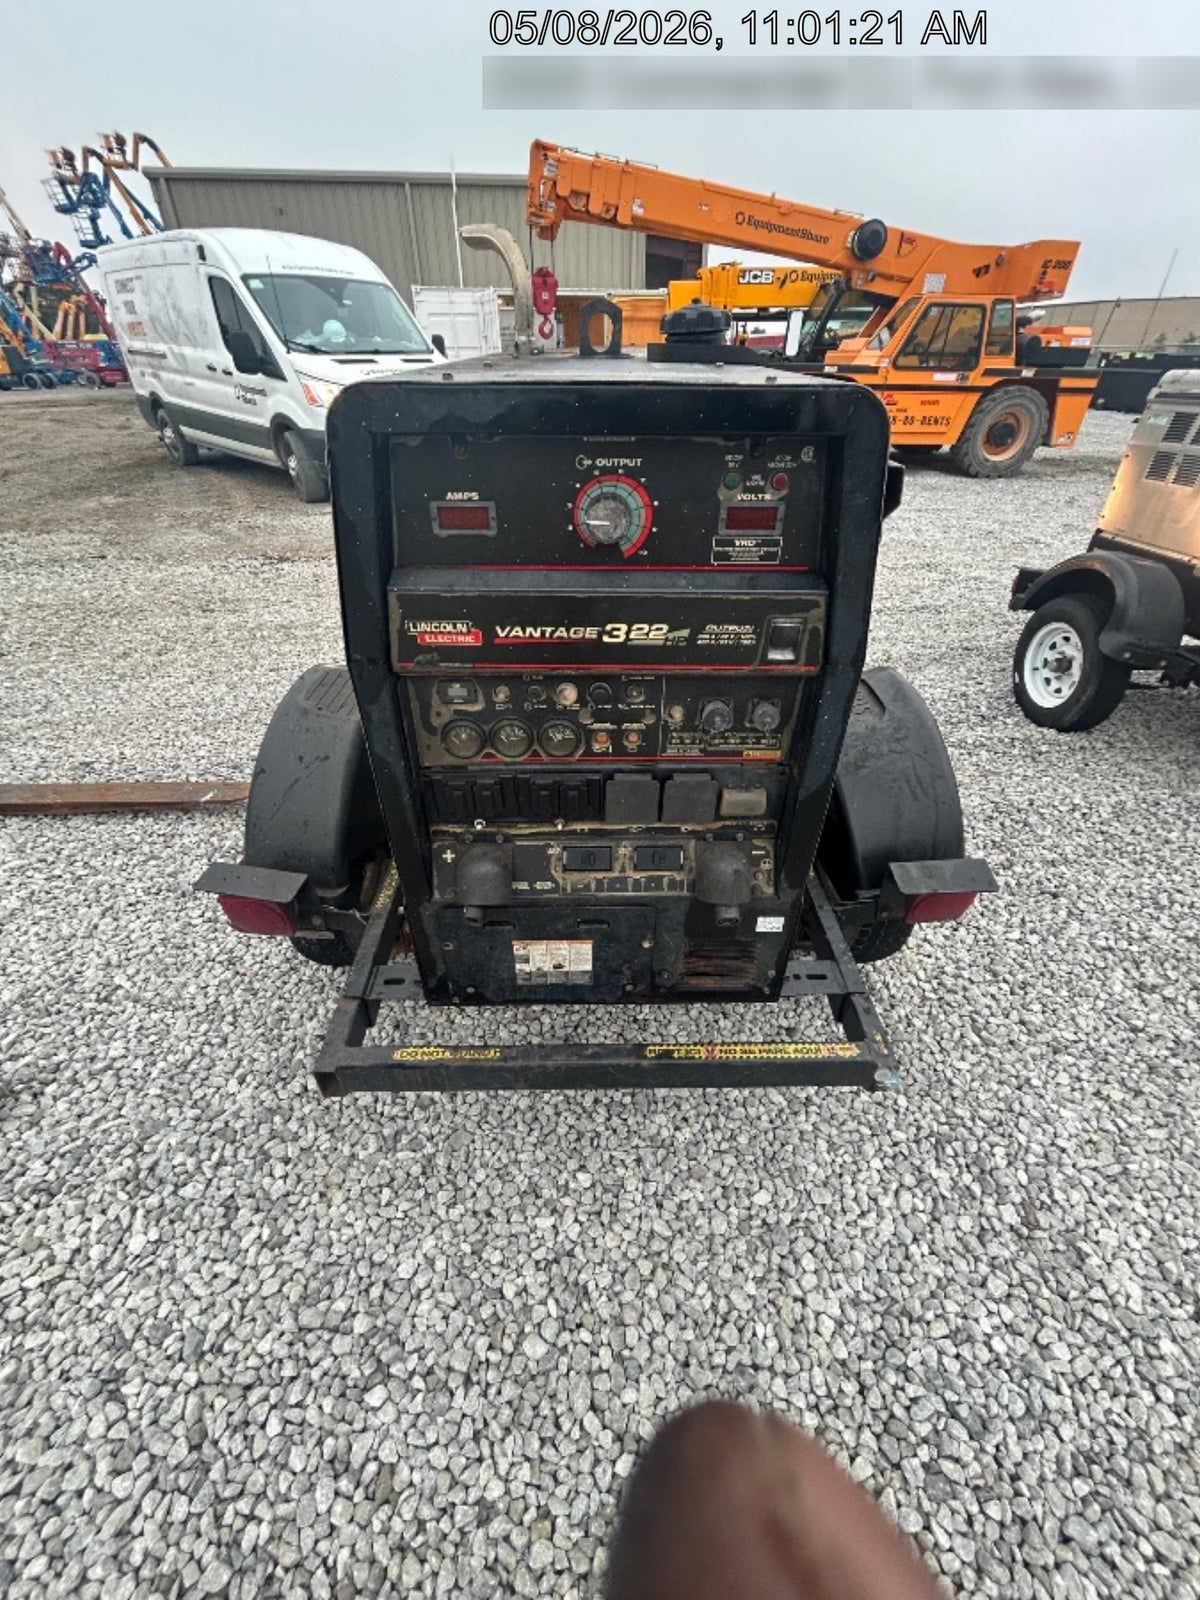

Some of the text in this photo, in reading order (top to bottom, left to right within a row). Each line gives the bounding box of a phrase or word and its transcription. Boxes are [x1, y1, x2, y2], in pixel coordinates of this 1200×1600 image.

[746, 214, 829, 244] EquipmentShare
[738, 270, 774, 284] JCB
[595, 458, 642, 466] OUTPUT
[446, 491, 479, 500] AMPS
[409, 623, 468, 633] LINCOLN
[495, 626, 600, 638] VANTAGE
[602, 623, 669, 643] 322
[425, 635, 475, 643] ELECTRIC
